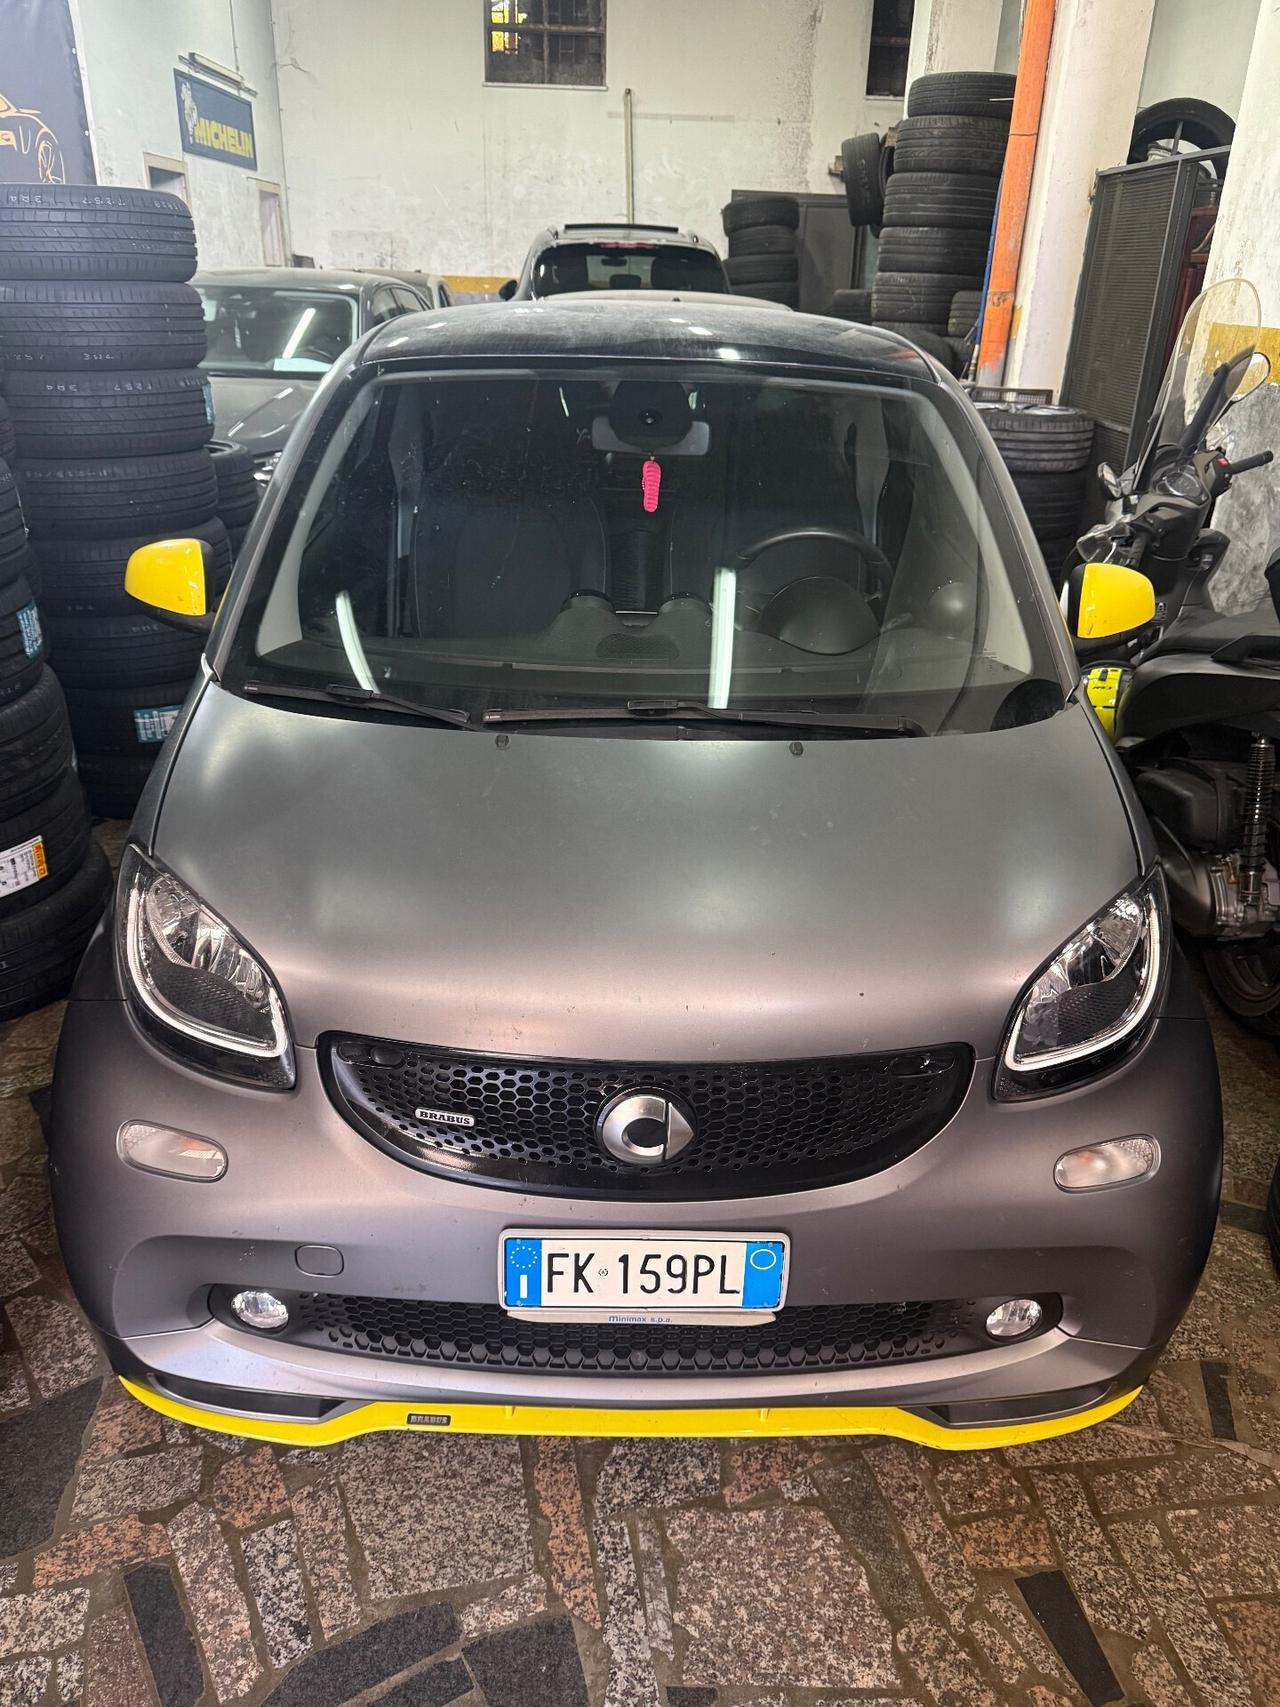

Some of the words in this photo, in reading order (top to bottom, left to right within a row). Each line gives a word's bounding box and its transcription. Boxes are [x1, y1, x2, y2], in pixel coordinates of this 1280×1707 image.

[194, 118, 254, 159] MICHELIN
[419, 1110, 471, 1125] BRABUS
[547, 1253, 595, 1294] FK
[618, 1253, 741, 1295] 159PL
[608, 1314, 647, 1322] minimax
